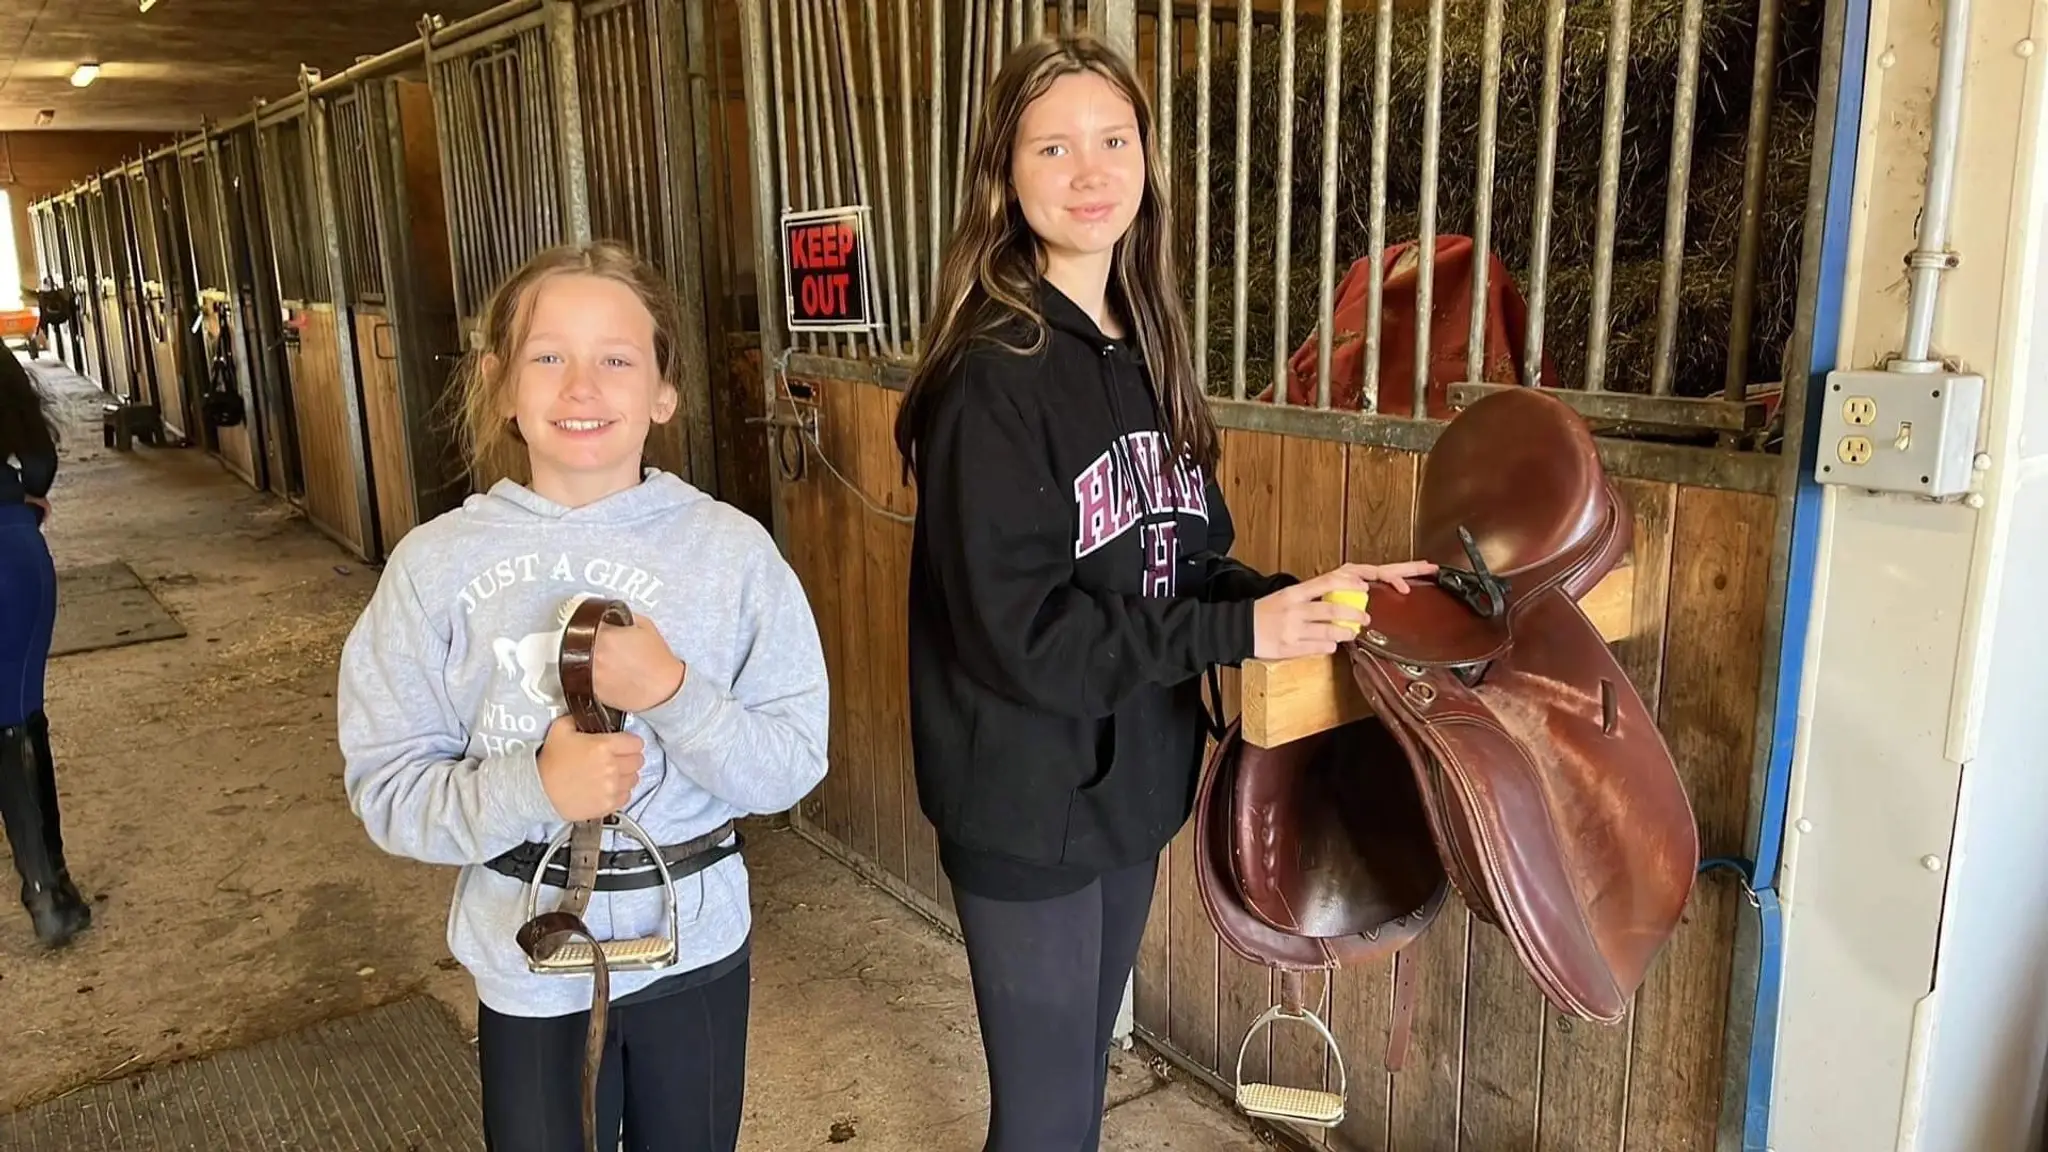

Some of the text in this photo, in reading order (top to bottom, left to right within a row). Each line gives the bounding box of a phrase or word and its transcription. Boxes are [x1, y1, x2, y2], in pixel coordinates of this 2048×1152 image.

[791, 224, 854, 269] KEEP
[802, 273, 849, 316] OUT
[1140, 521, 1178, 598] H
[457, 552, 664, 613] JUST A GIRL
[483, 698, 537, 733] Who
